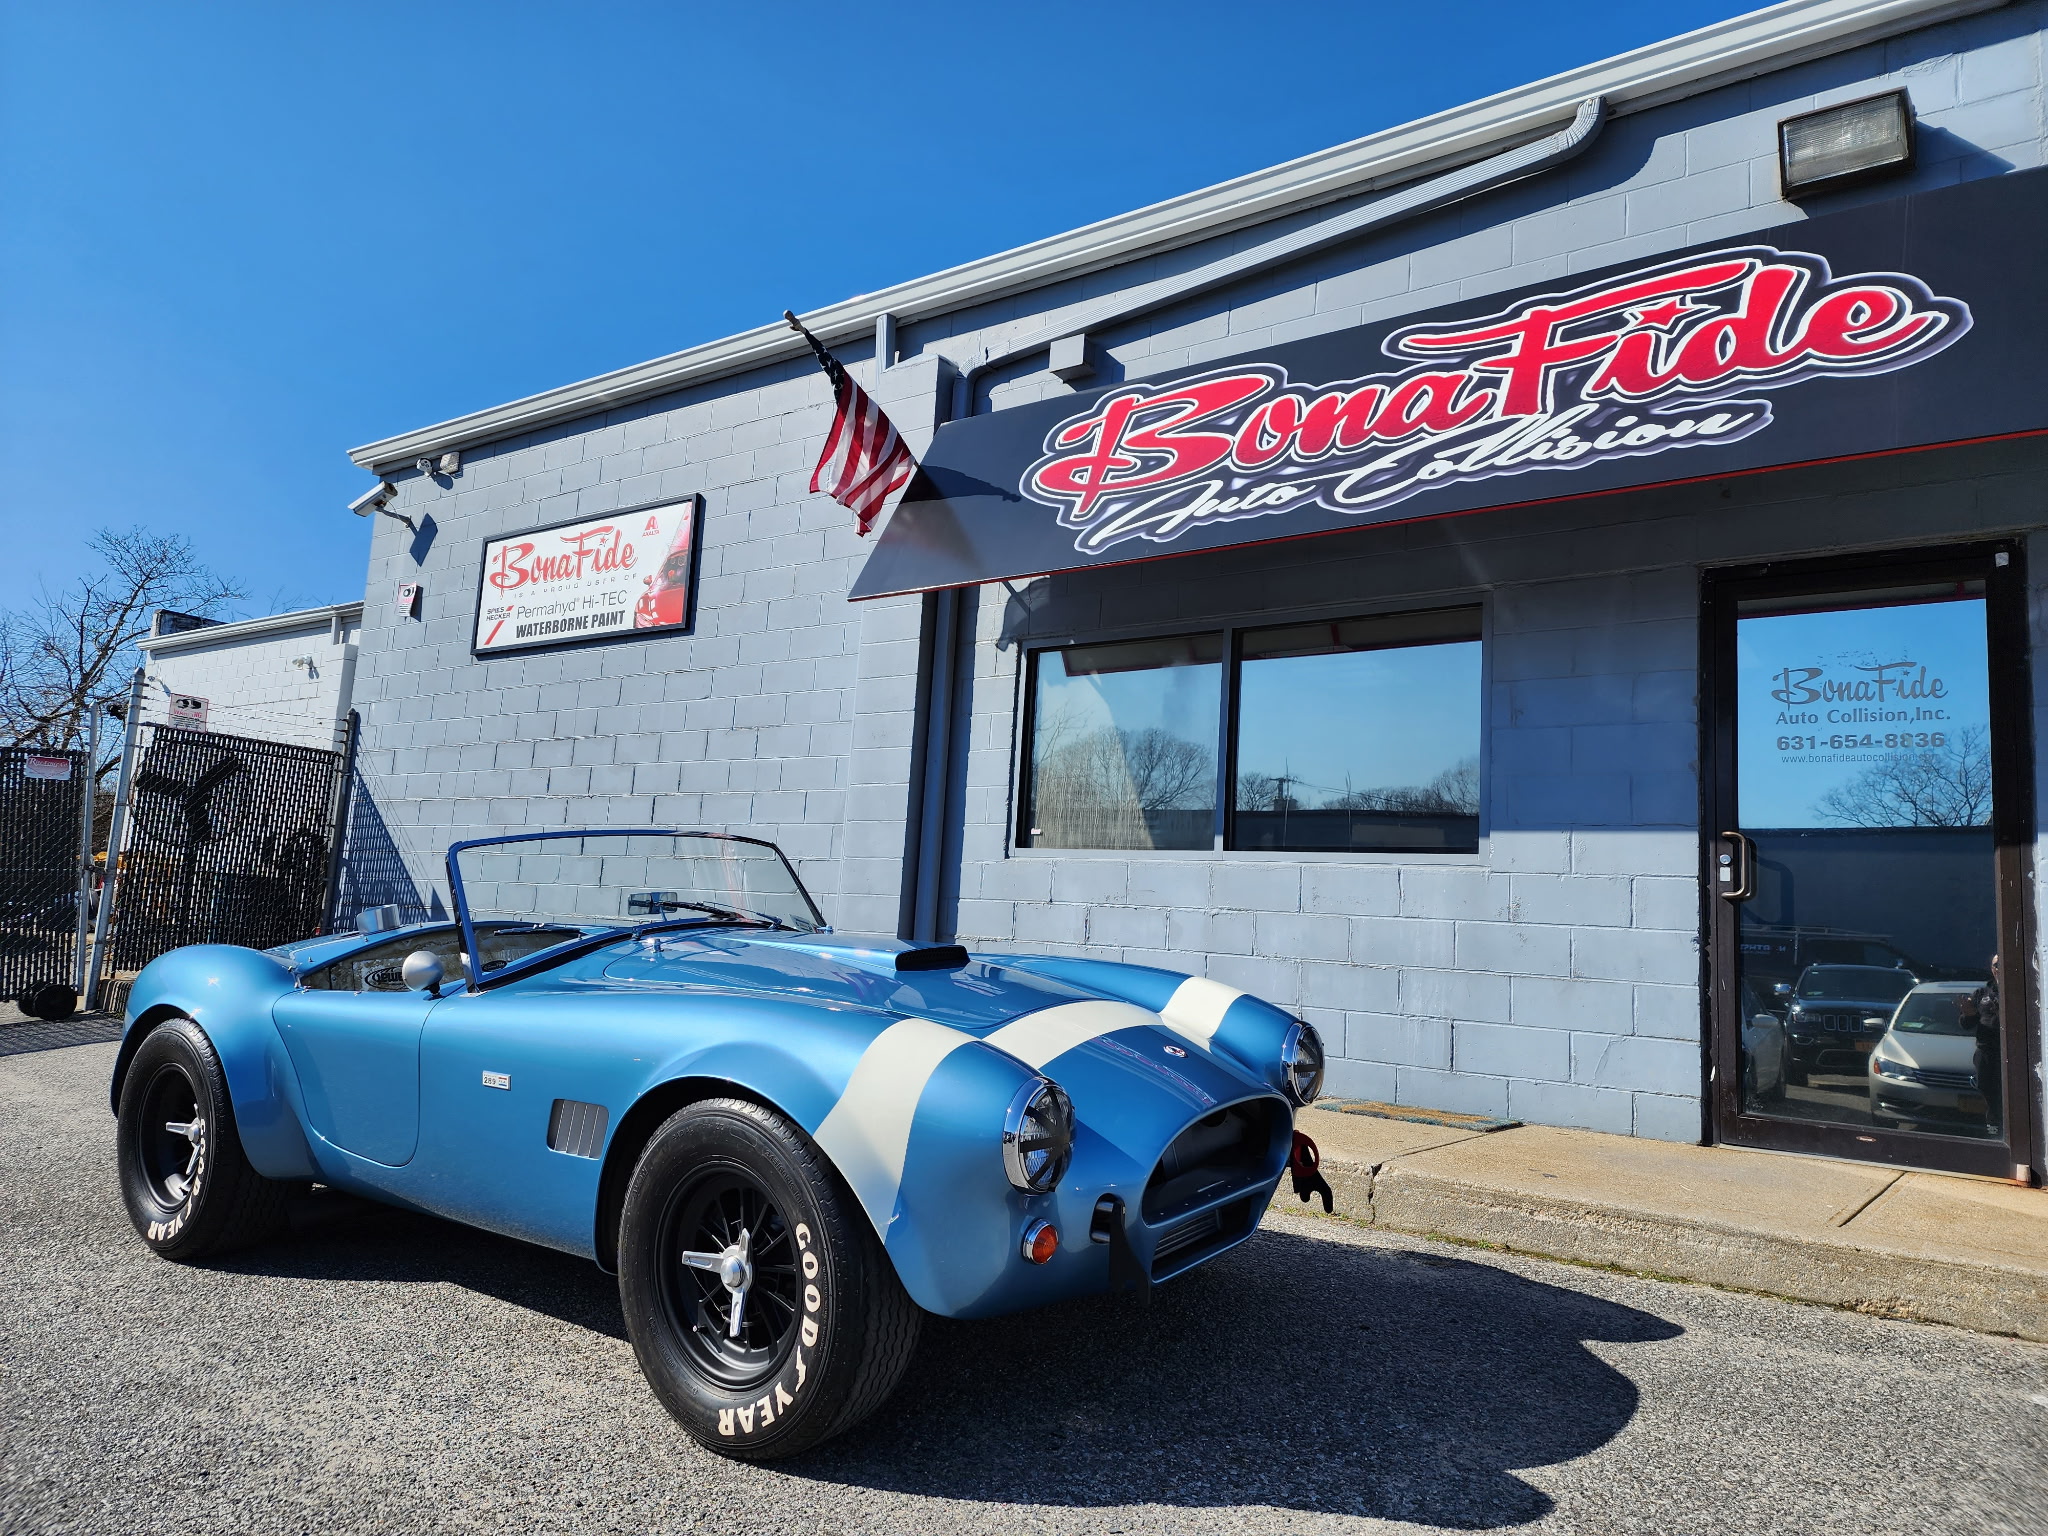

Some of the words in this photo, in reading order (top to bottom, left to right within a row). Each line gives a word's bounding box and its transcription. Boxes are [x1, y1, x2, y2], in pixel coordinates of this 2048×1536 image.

[1032, 255, 1948, 521] BonaFide
[1088, 480, 1316, 545] Auto
[1335, 402, 1754, 503] Collision
[489, 525, 637, 599] BonaFide
[516, 615, 589, 639] WATERBORNE
[591, 610, 626, 629] PAINT
[582, 590, 627, 610] Hi-TEC
[1771, 660, 1949, 711] BonaFide
[1776, 711, 1819, 725] Auto
[1776, 731, 1946, 751] 631-654-8836
[147, 1214, 186, 1242] YEAR
[795, 1222, 821, 1348] GOOD
[718, 1381, 794, 1437] YEAR
